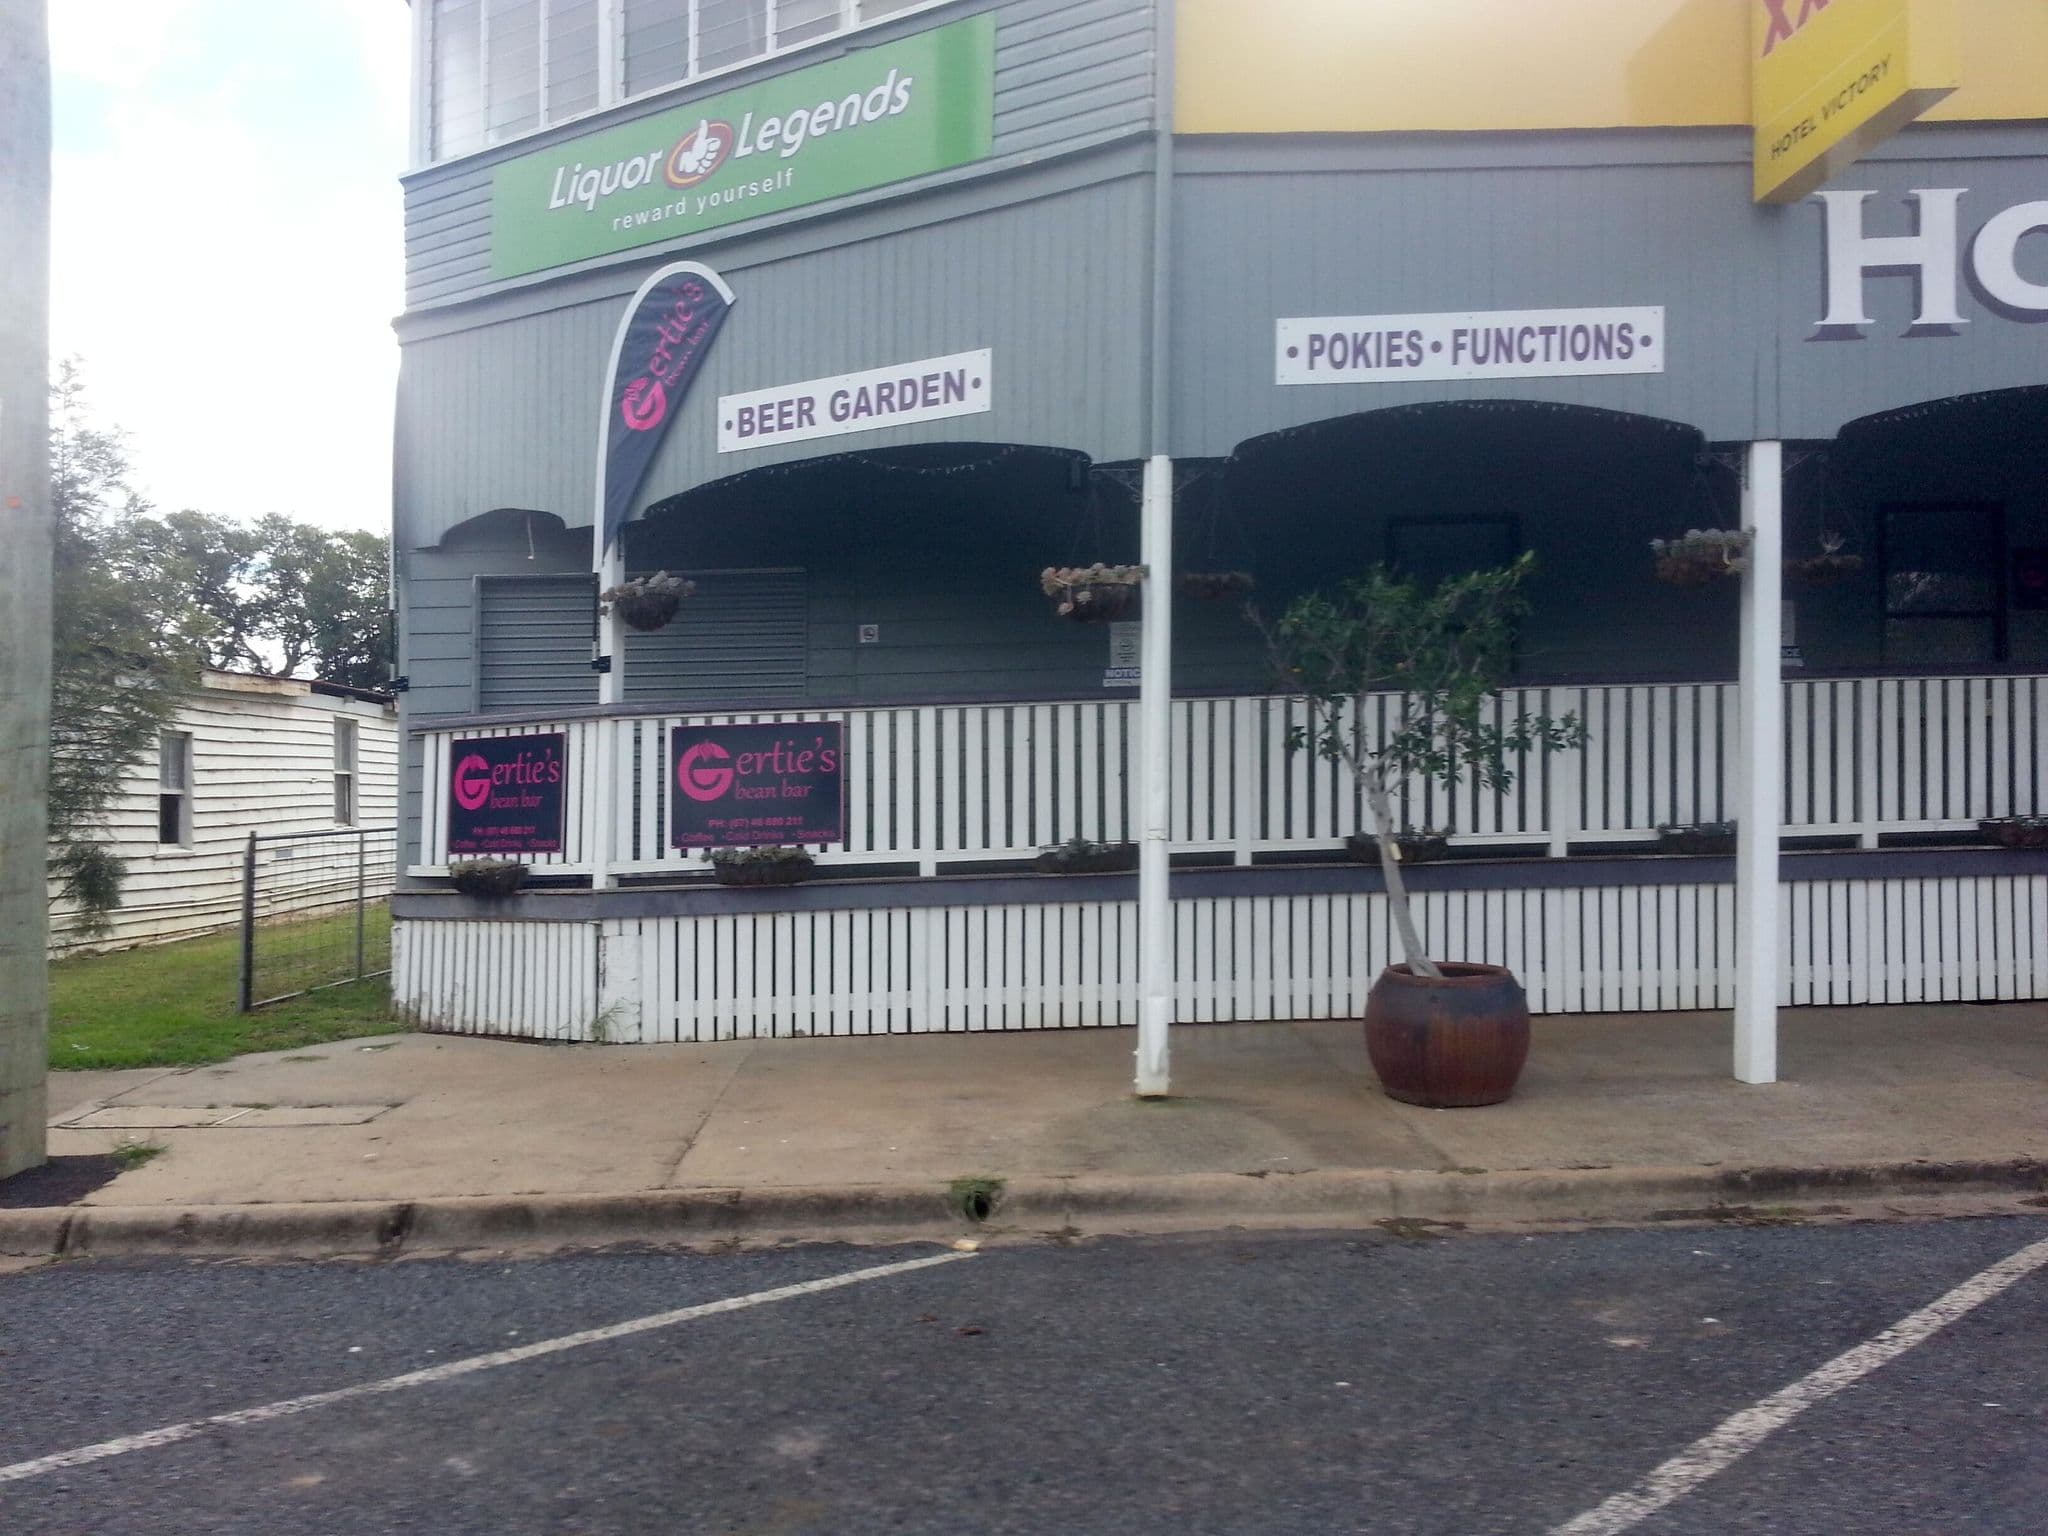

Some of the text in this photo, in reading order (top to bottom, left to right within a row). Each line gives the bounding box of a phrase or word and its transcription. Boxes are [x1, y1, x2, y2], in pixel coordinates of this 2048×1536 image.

[548, 69, 913, 210] Liquor Legends
[1769, 52, 1892, 161] HOTEL VICTORY
[612, 167, 795, 231] reward yourself
[1307, 322, 1635, 371] POKIES FUNCTIONS
[737, 368, 966, 437] BEER GARDEN
[735, 778, 813, 800] bean bar
